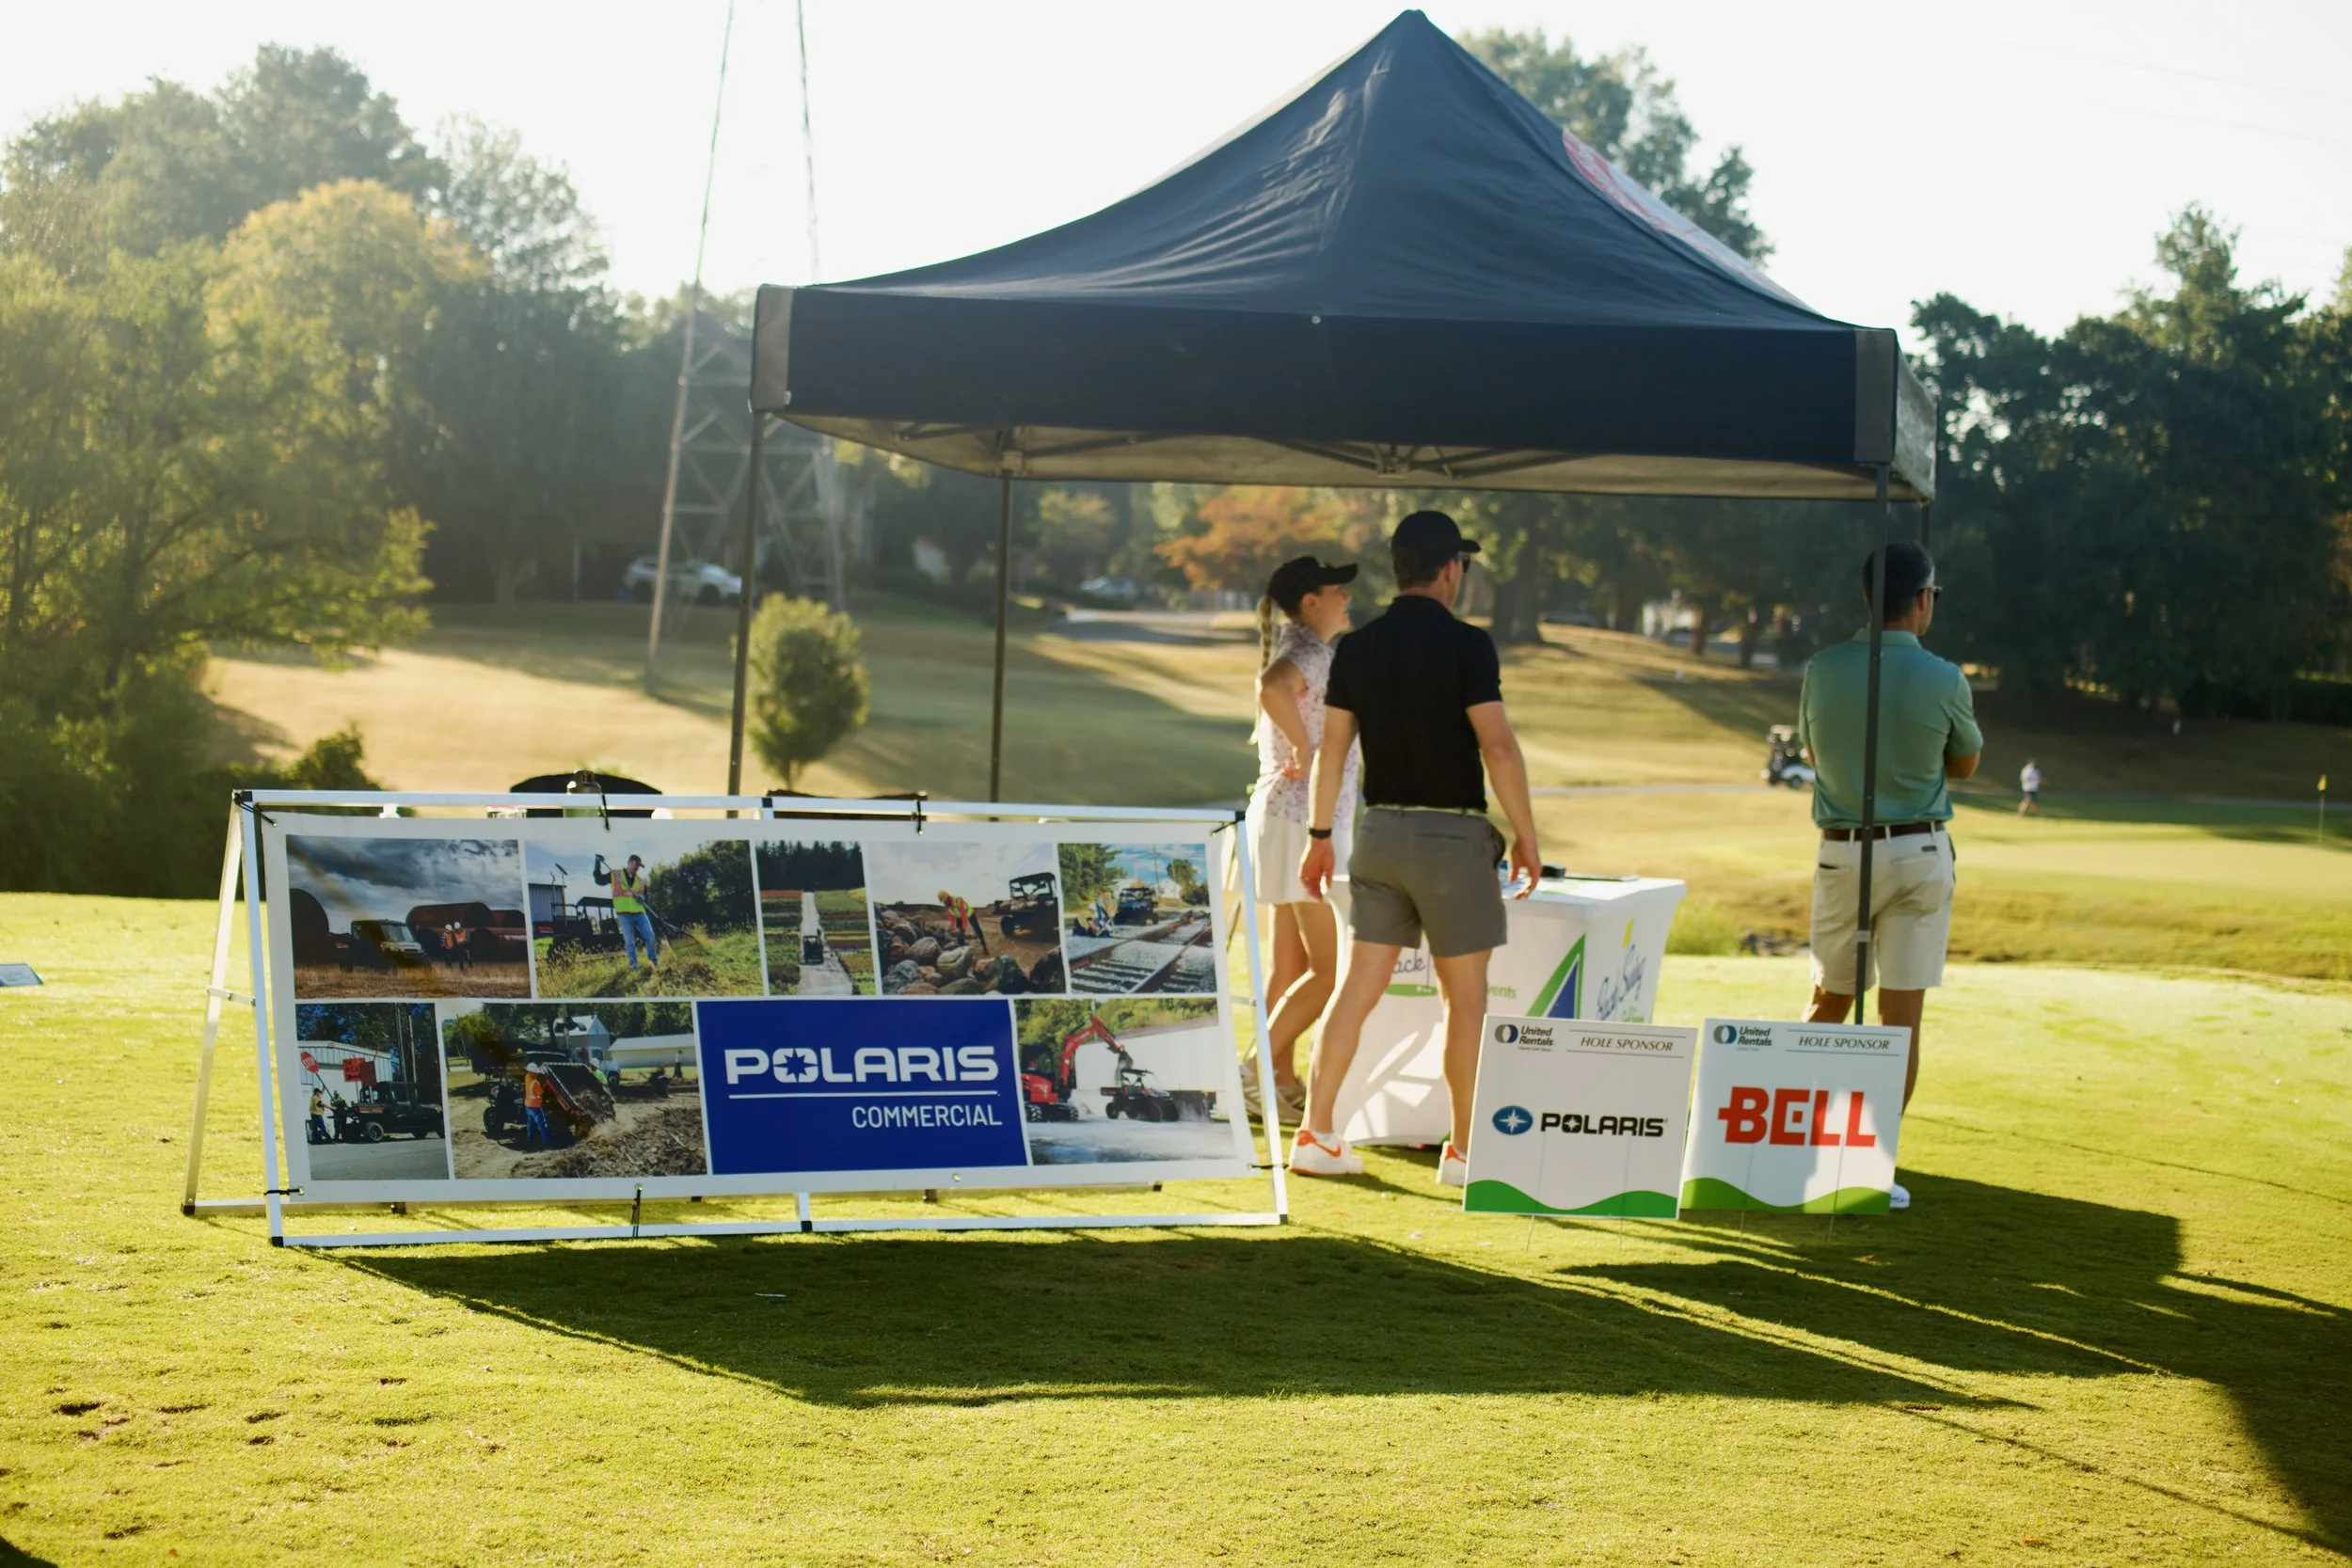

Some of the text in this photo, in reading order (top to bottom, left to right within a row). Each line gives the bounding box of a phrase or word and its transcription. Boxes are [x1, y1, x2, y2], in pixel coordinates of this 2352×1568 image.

[1392, 948, 1426, 974] ack
[1486, 985, 1517, 999] vents
[1520, 1025, 1553, 1037] United
[1739, 1026, 1771, 1037] United
[1518, 1035, 1554, 1046] Rentals
[1581, 1037, 1674, 1052] HOLE SPONSOR
[1738, 1036, 1772, 1046] Rentals
[1799, 1037, 1890, 1050] HOLE SPONSOR
[724, 1046, 999, 1085] POLARIS
[851, 1104, 1003, 1129] COMMERCIAL
[1717, 1085, 1877, 1148] BELL
[1540, 1113, 1664, 1137] POLARIS
